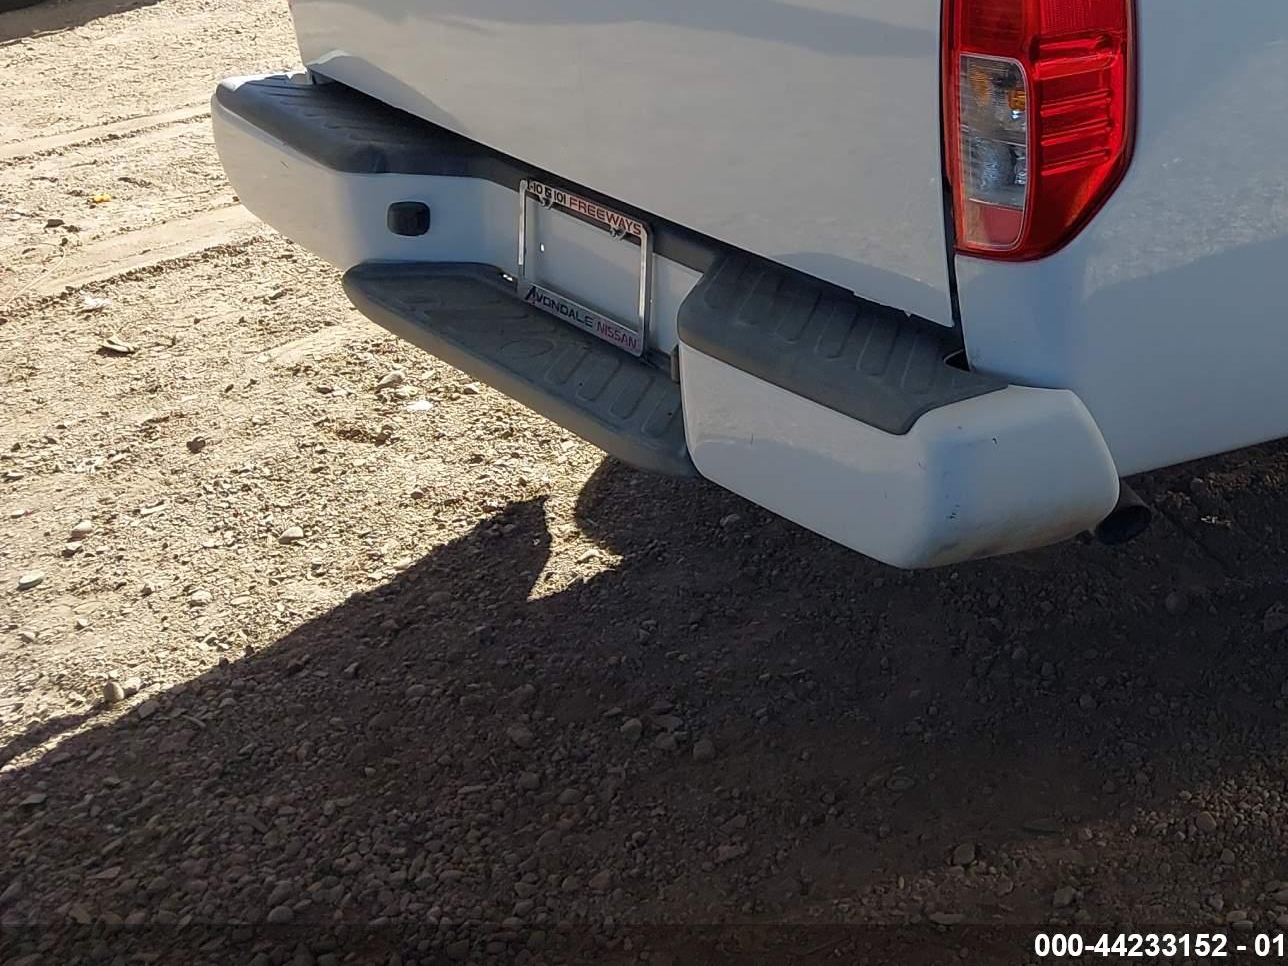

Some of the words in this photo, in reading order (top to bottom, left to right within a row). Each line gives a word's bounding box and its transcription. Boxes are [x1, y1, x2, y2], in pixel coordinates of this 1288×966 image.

[569, 196, 642, 235] FREEWAYS
[524, 285, 594, 329] AVONDALE
[595, 320, 638, 349] NISSAN
